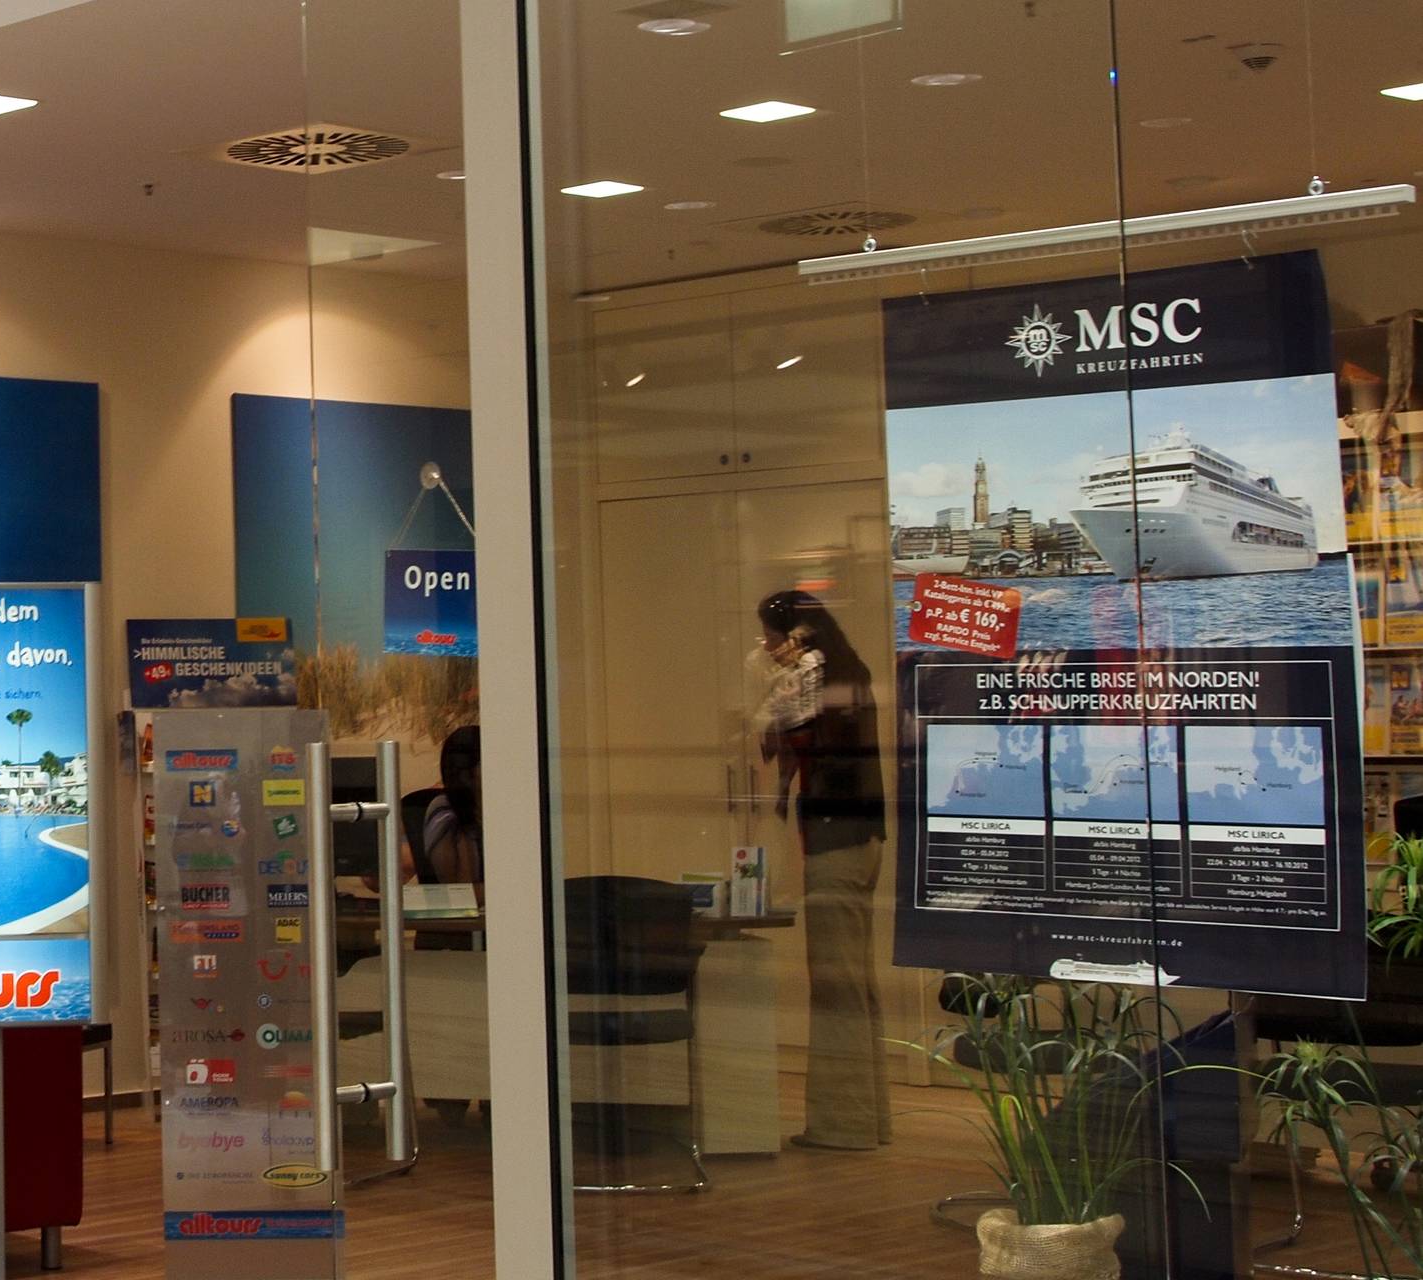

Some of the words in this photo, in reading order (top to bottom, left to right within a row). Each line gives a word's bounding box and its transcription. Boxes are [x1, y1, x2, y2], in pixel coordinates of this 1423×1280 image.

[1074, 298, 1202, 353] MSC
[1076, 352, 1204, 375] KREUZFAHRTEN
[404, 565, 470, 597] Open
[960, 608, 970, 624] €
[974, 611, 1006, 632] 169,-
[936, 623, 970, 636] RAPIDO
[942, 633, 970, 646] Service
[7, 641, 74, 668] davon.
[142, 646, 226, 660] HIMMLISCHE
[175, 662, 283, 677] GESCHENKIDEEN
[976, 673, 1013, 689] EINE
[1018, 672, 1085, 689] FRISCHE
[1090, 672, 1137, 689] BRISE
[1144, 672, 1163, 688] IM
[1168, 671, 1260, 688] NORDEN!
[979, 695, 1005, 710] z.B.
[1009, 694, 1257, 710] SCHNUPPERKREUZFAHRTEN
[961, 821, 980, 831] MSC
[981, 822, 1011, 831] LIRICA
[1088, 825, 1107, 835] MSC
[1109, 826, 1141, 836] LIRICA
[1227, 829, 1250, 839] MSC
[1252, 831, 1285, 840] LIRICA
[277, 918, 300, 927] ADAC
[180, 1096, 239, 1109] AMEROPA
[179, 1212, 261, 1235] alltours
